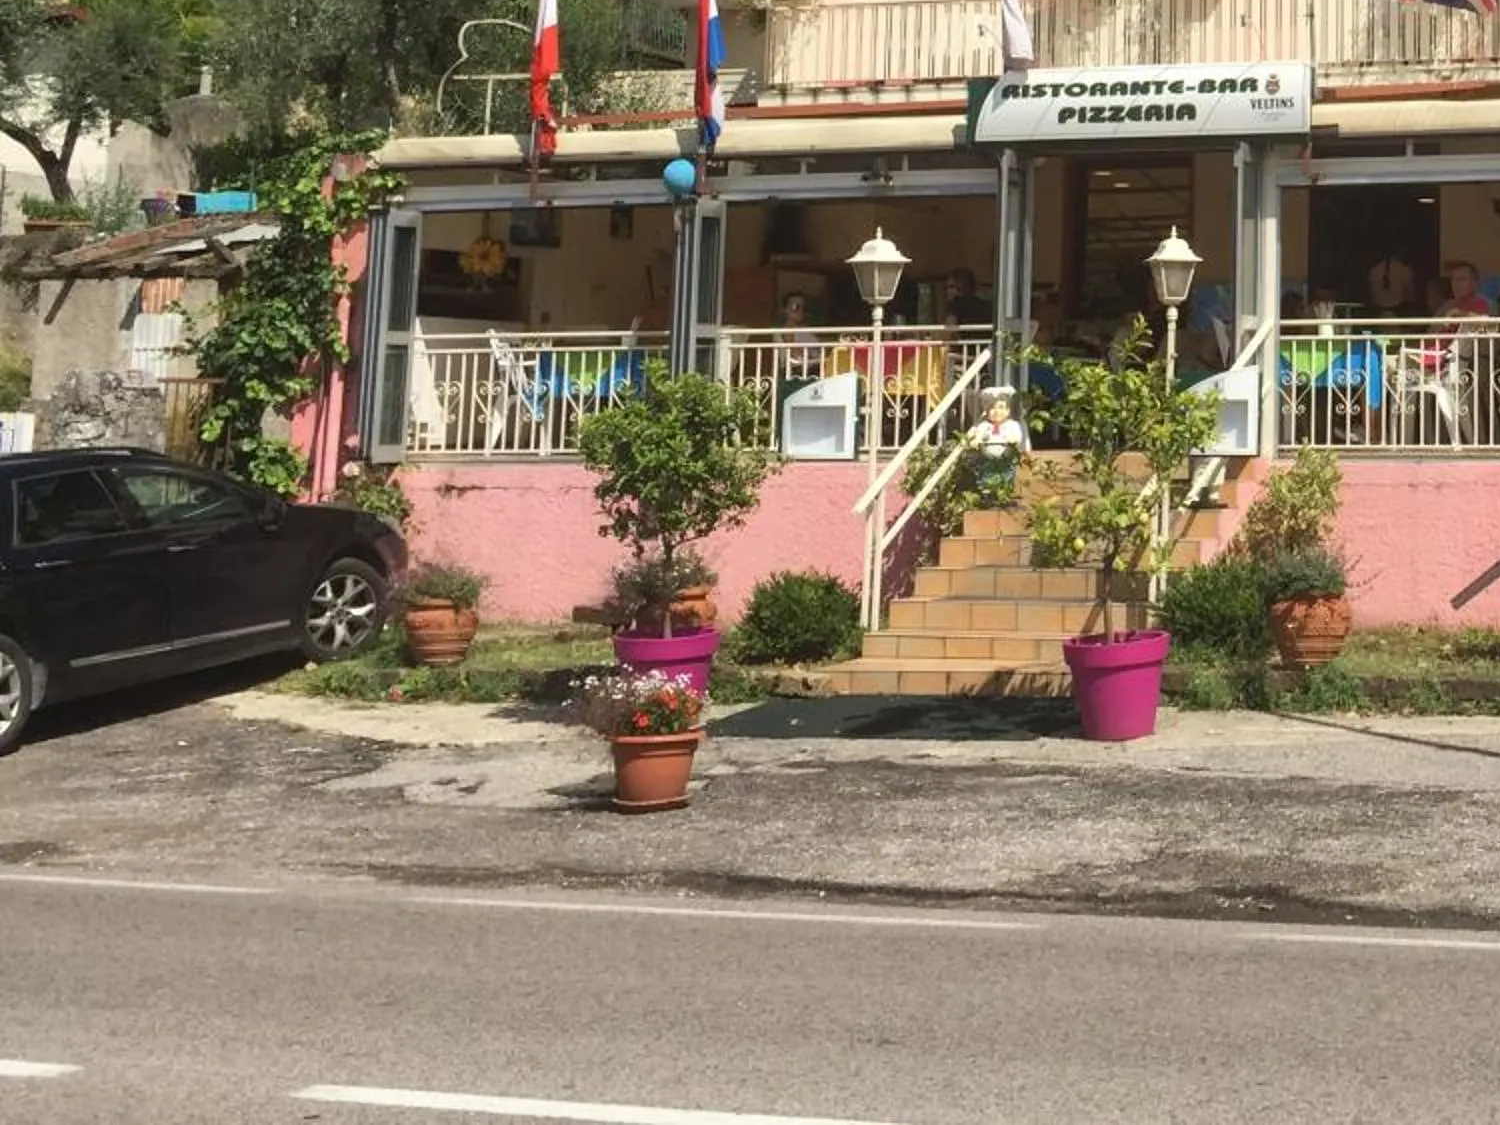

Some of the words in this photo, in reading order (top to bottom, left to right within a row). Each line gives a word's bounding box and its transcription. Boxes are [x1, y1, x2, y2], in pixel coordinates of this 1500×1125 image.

[1001, 76, 1259, 100] RISTORANTE-BAR
[1057, 102, 1198, 125] PIZZERIA
[1250, 97, 1295, 110] VELTINS
